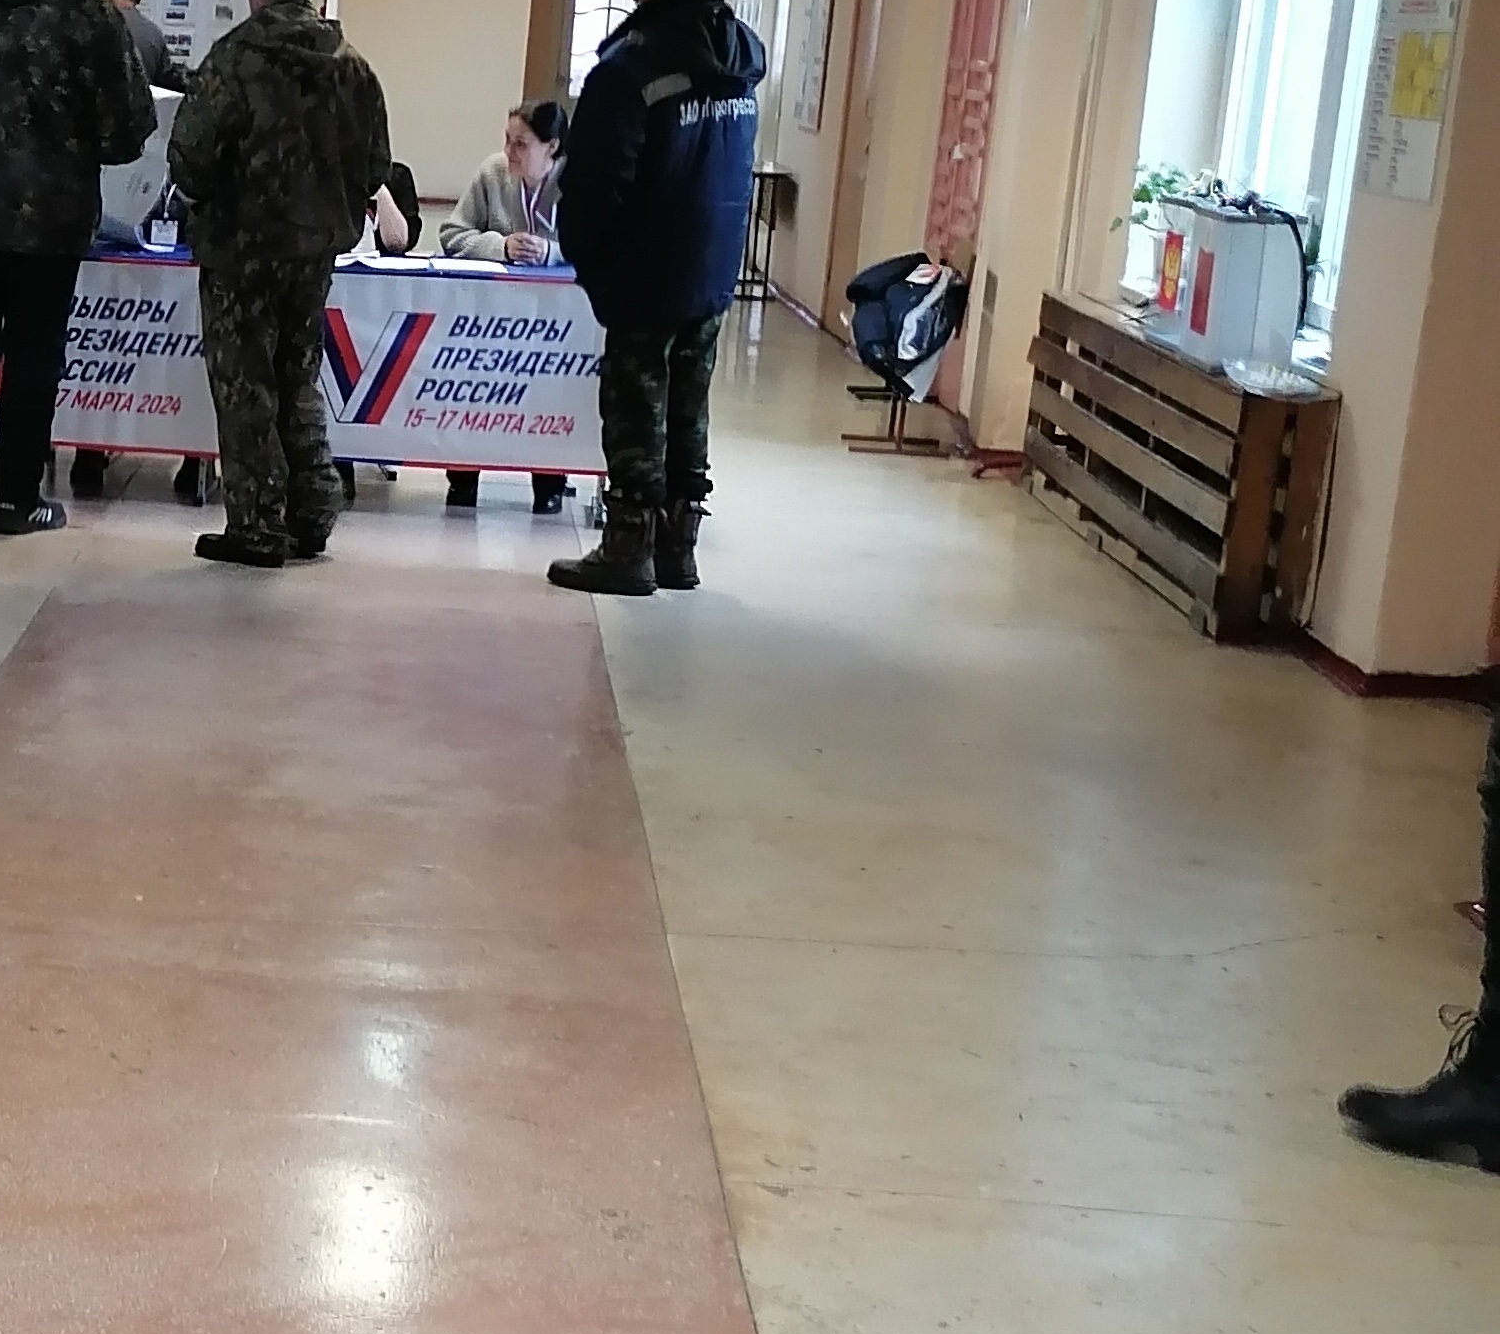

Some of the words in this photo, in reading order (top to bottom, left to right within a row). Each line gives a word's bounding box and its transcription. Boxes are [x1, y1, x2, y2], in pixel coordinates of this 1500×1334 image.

[66, 327, 205, 357] РЕЗИДЕНТА
[448, 315, 573, 343] ВЫБОРЫ
[63, 358, 136, 385] ССИИ
[431, 346, 603, 378] ПРЕЗИДЕНТА
[70, 389, 135, 413] МАРТА
[136, 393, 182, 416] 2024
[415, 377, 529, 406] РОССИИ
[458, 411, 526, 434] МАРТА
[526, 415, 576, 437] 2024
